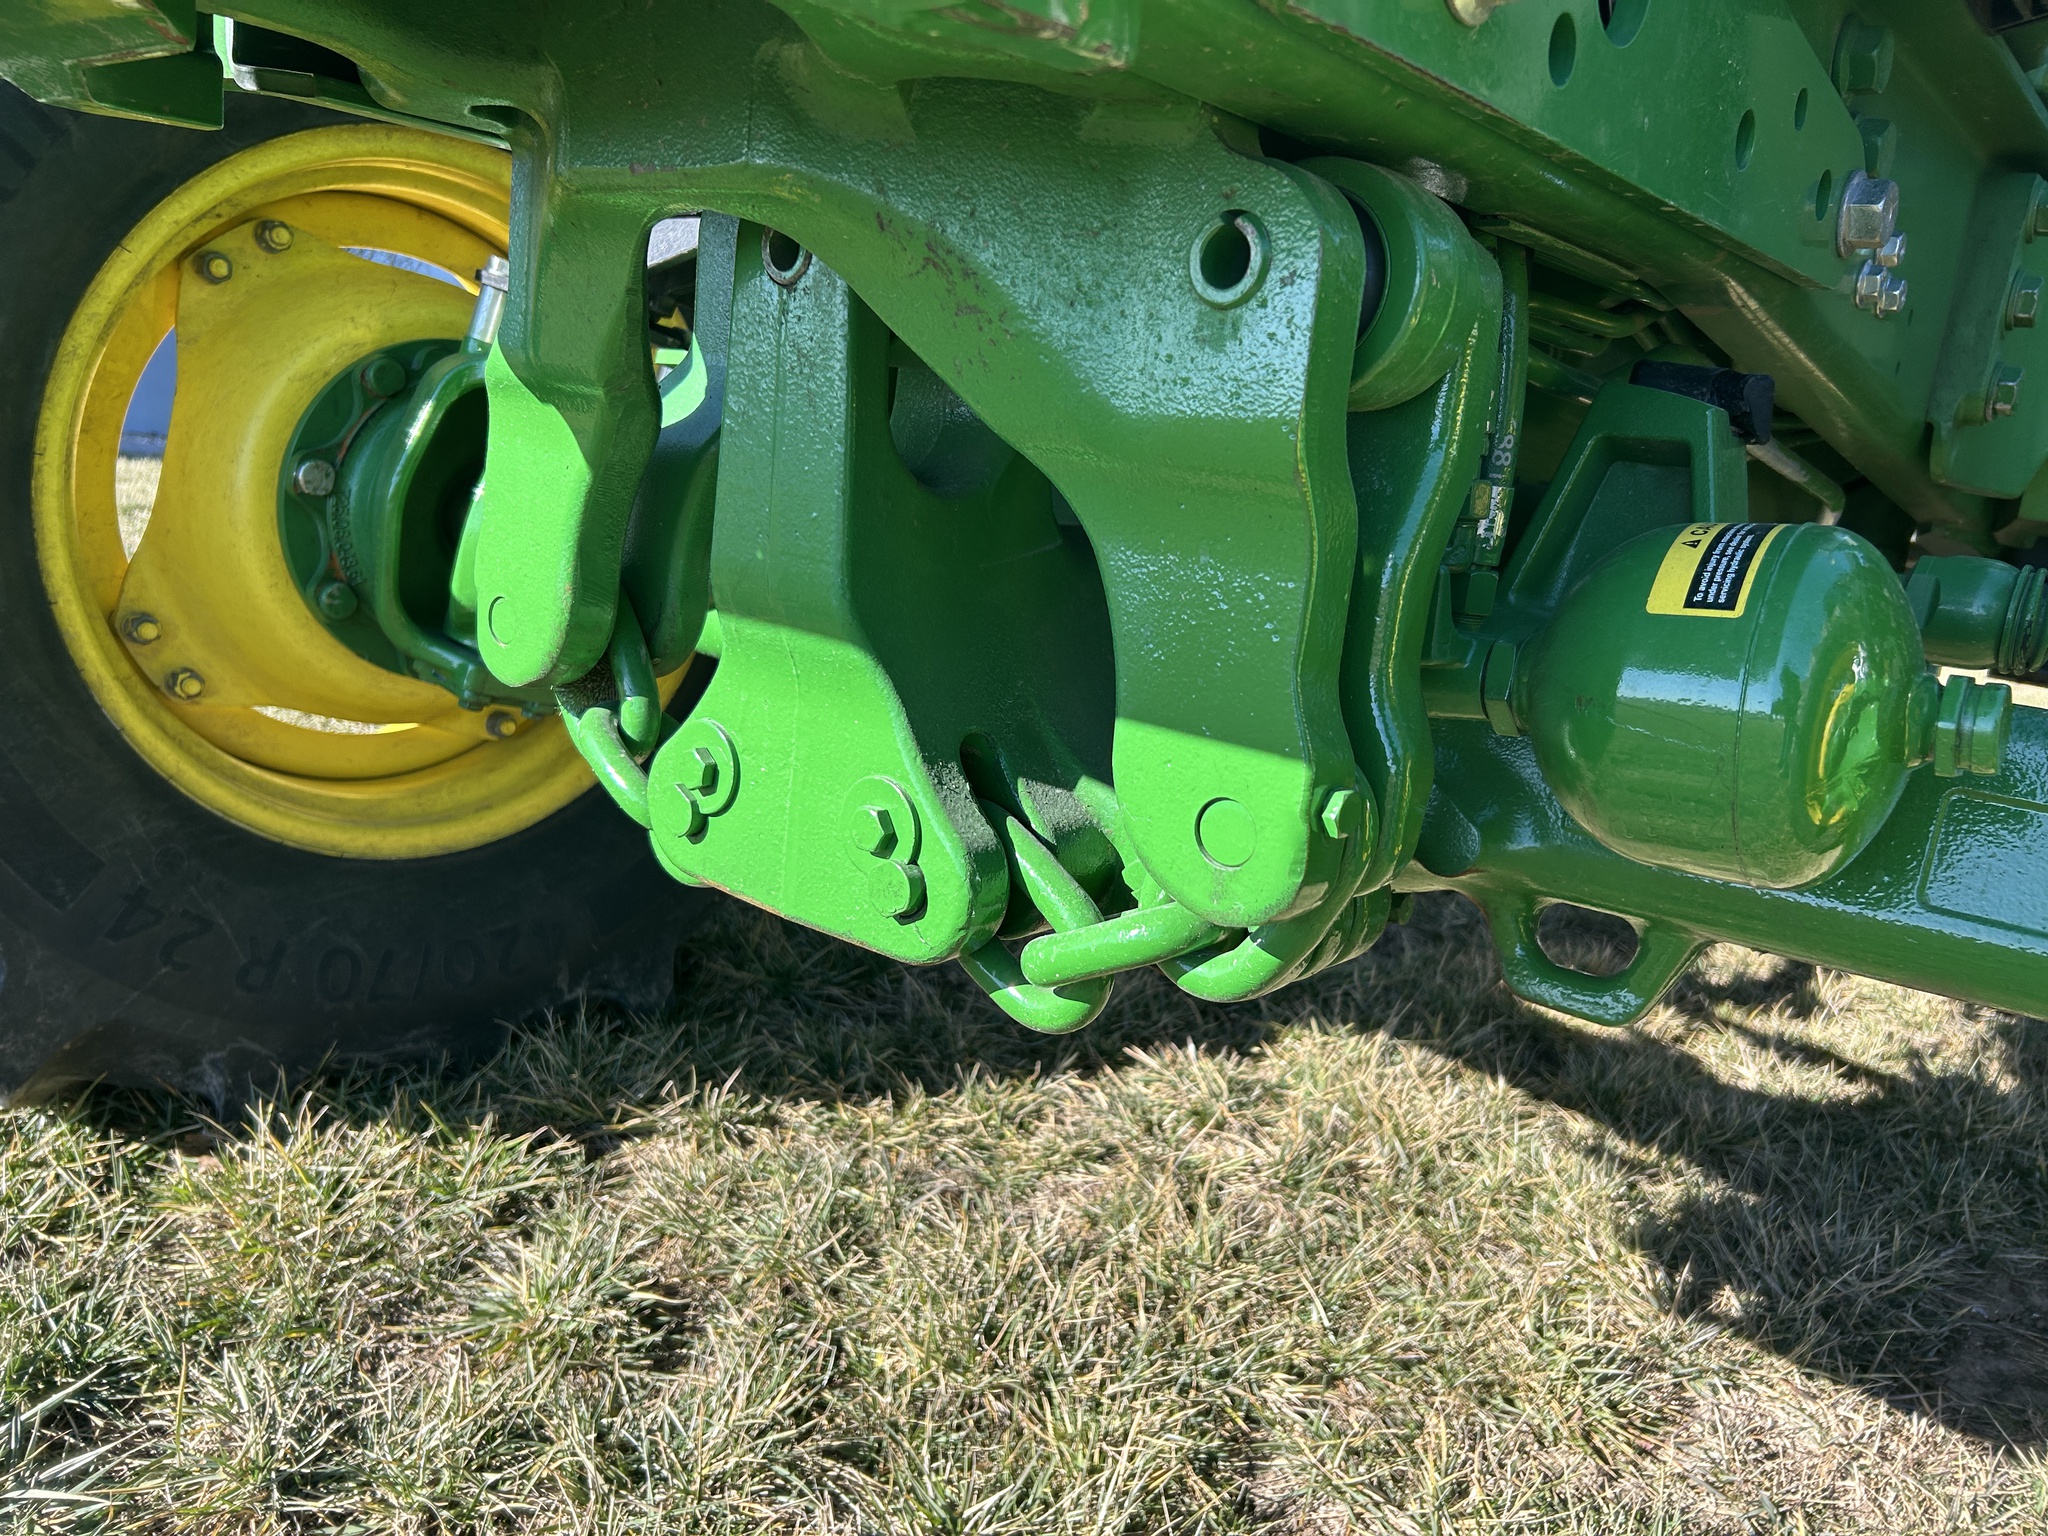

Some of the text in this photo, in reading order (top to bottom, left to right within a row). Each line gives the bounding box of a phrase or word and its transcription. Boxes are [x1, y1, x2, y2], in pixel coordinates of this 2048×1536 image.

[1712, 542, 1726, 555] from
[1704, 554, 1720, 572] injury
[1699, 572, 1711, 591] avoid
[1707, 583, 1718, 603] under
[1714, 555, 1731, 582] pressure,
[1718, 573, 1735, 603] servicing
[1727, 549, 1745, 573] hydraulic
[1693, 592, 1704, 602] To
